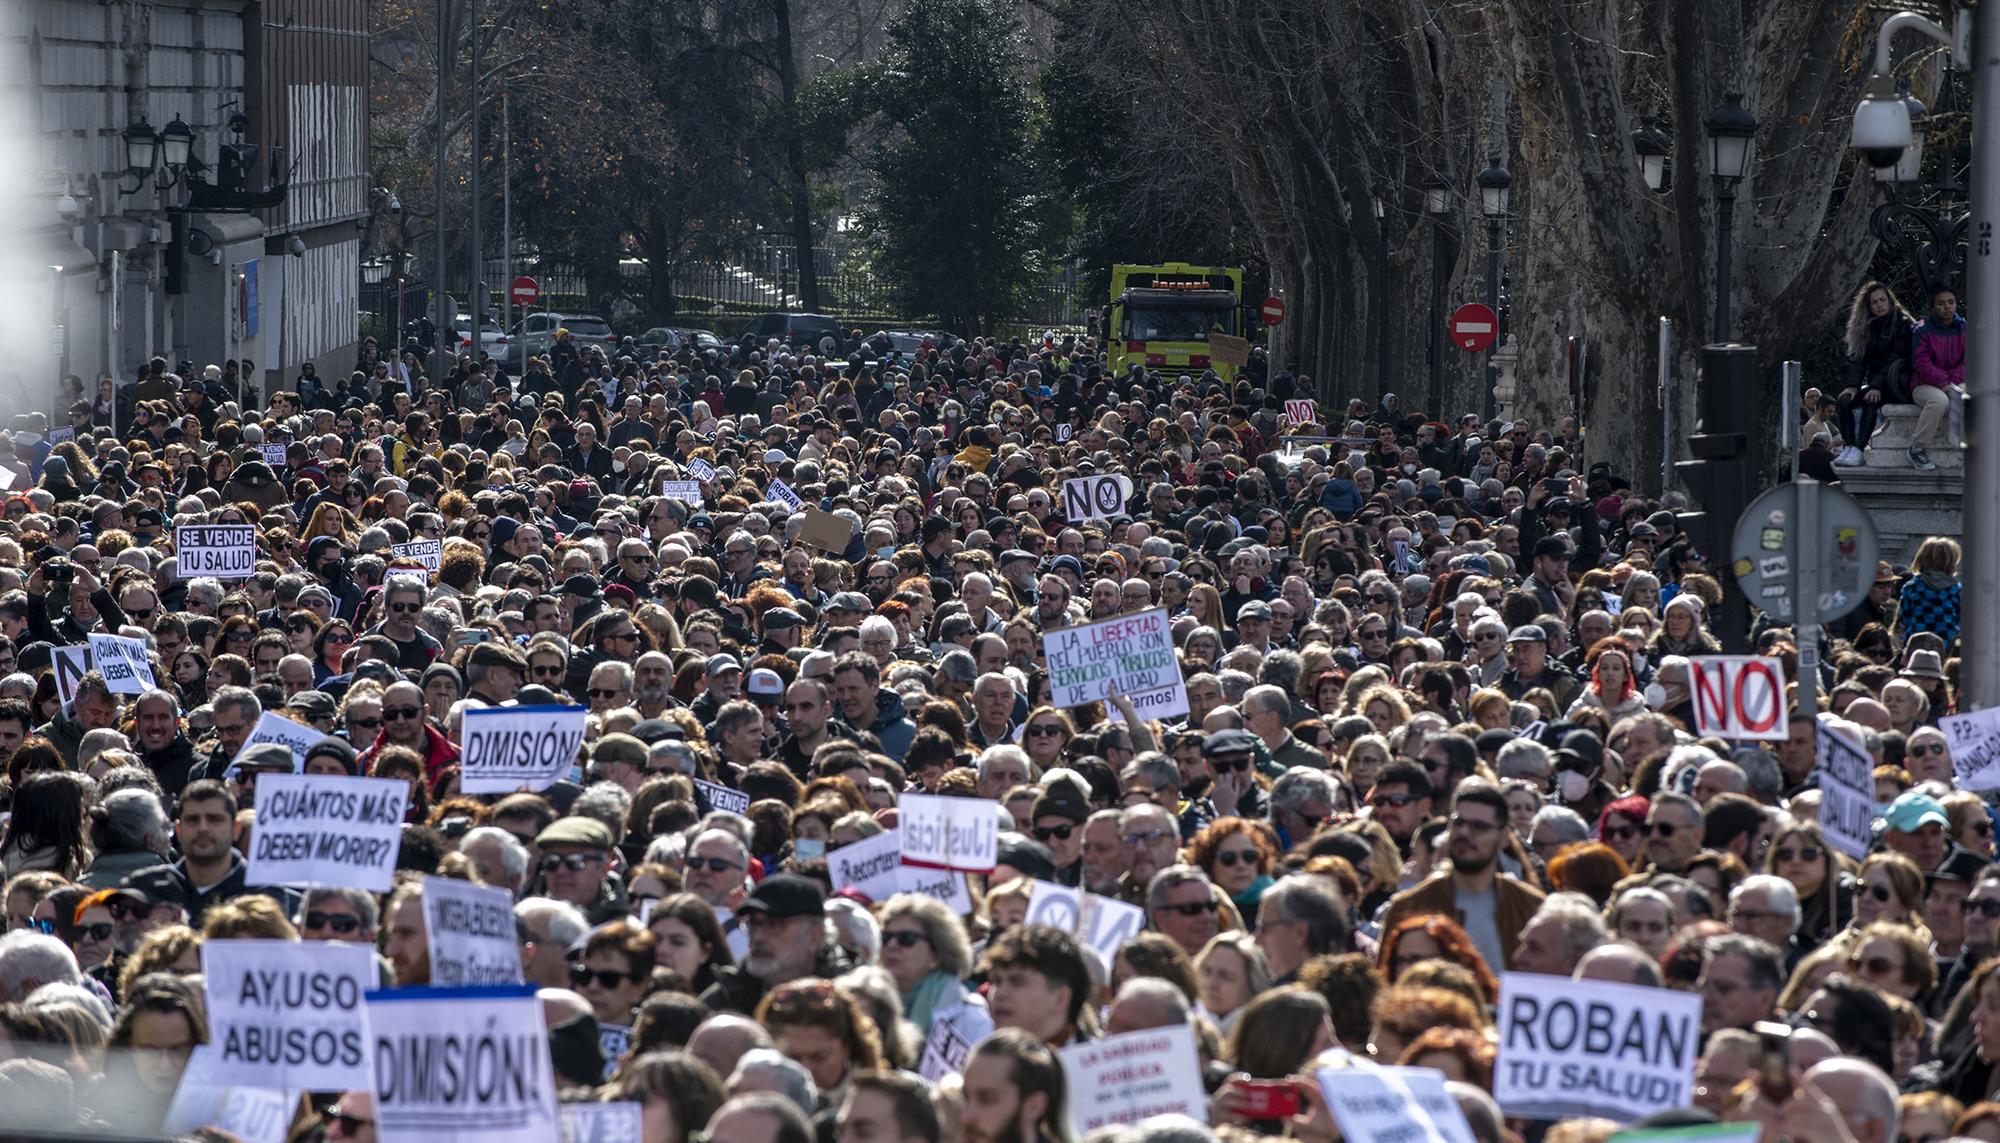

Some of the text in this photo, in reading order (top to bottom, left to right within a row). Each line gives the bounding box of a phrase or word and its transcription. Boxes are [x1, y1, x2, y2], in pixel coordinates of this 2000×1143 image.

[1286, 401, 1313, 423] NO
[1065, 477, 1122, 518] NO
[181, 530, 252, 546] SE VENDE
[393, 542, 439, 557] SE VENDE
[182, 550, 251, 570] TU SALUD
[1049, 631, 1165, 671] DEL PUEBLO SON
[1061, 615, 1161, 652] LA LIBERTAD
[102, 661, 135, 681] DEBEN
[1050, 659, 1111, 689] SERVICIOS
[1068, 683, 1088, 703] DE
[1692, 660, 1781, 732] NO
[258, 783, 401, 826] ¿CUÁNTOS MÁS
[709, 788, 747, 815] VENDE
[256, 831, 391, 868] DEBEN MORIR?
[222, 1025, 362, 1067] ABUSOS
[1508, 994, 1690, 1069] ROBAN
[377, 1015, 540, 1103] DIMISIÓN!
[1507, 1059, 1682, 1105] TU SALUD!
